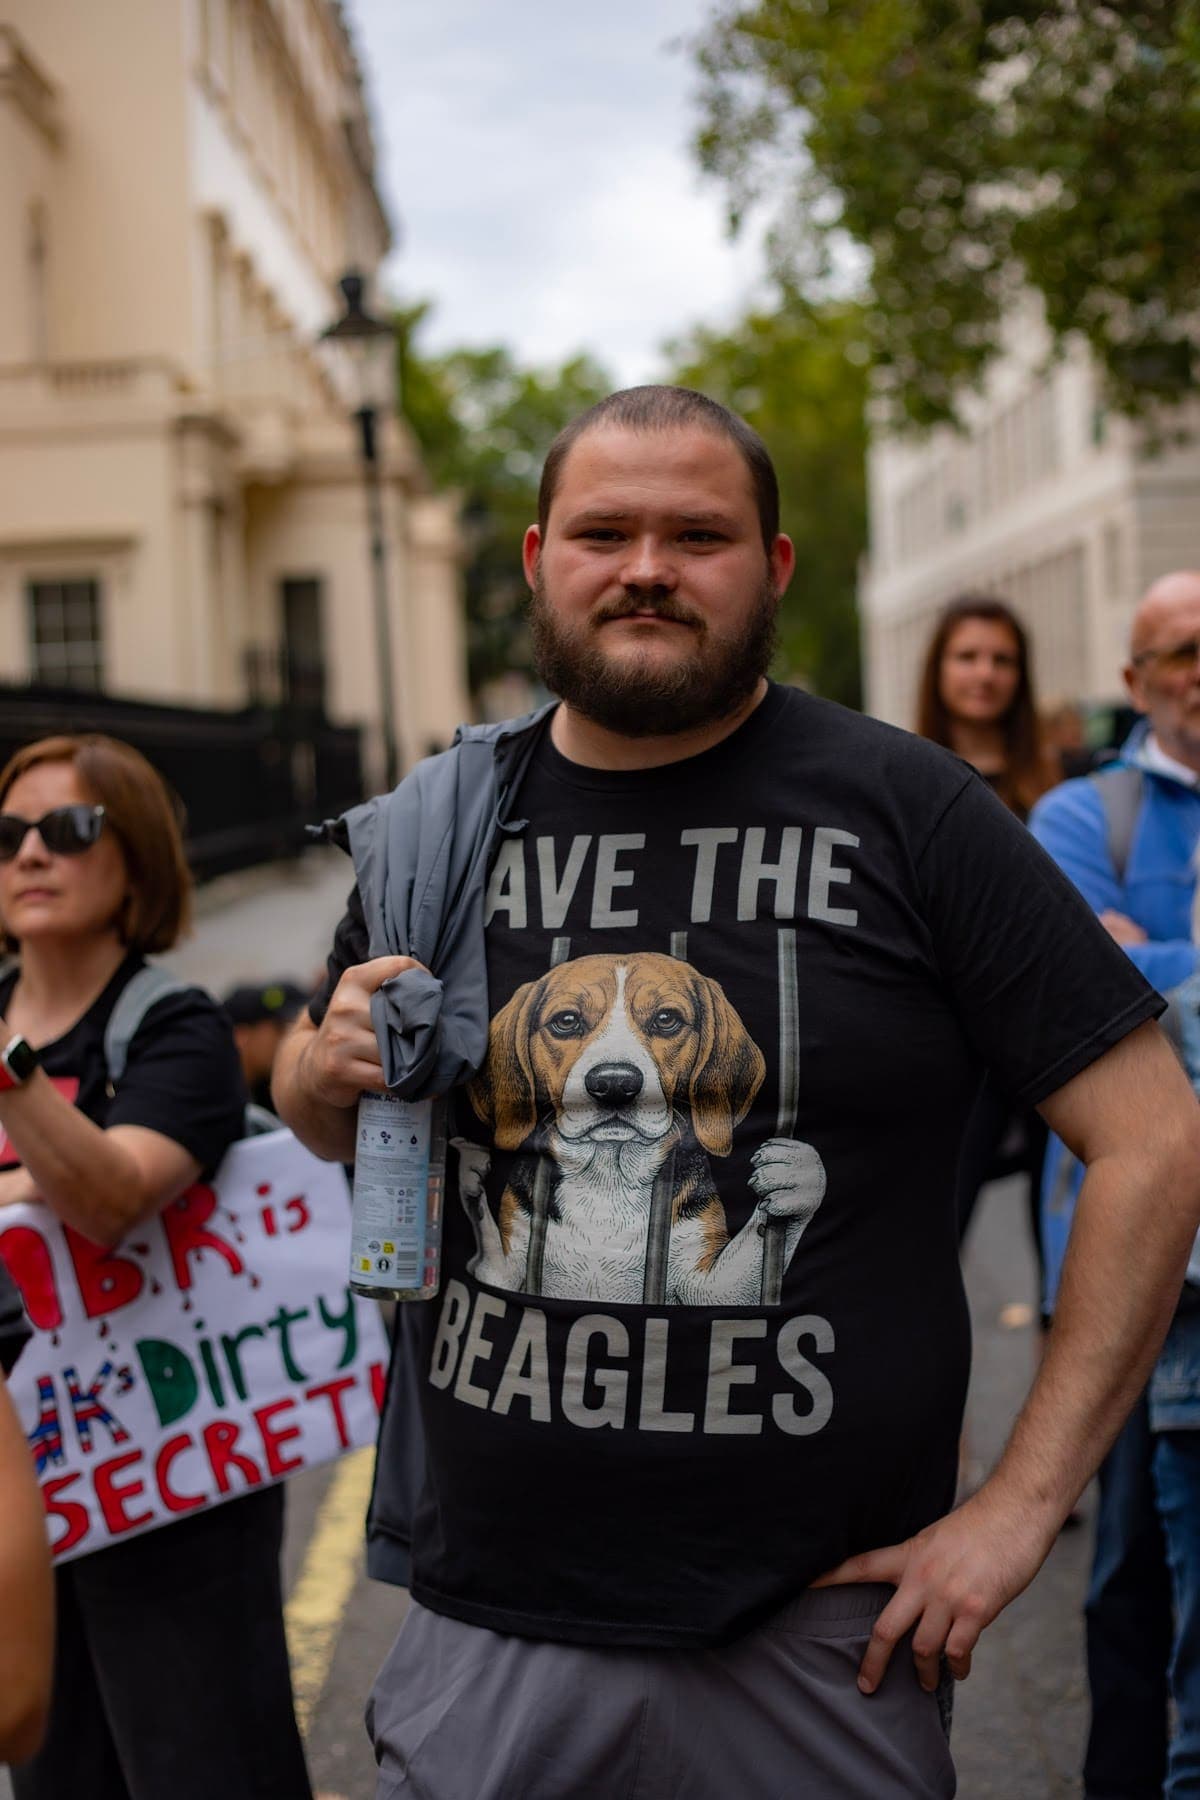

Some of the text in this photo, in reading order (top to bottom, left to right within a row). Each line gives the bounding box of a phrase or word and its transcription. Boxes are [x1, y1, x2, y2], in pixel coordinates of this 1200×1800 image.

[484, 826, 860, 929] AVE THE
[0, 1183, 243, 1330] BR
[256, 1183, 311, 1237] is
[136, 1286, 357, 1427] Dirty
[428, 1278, 836, 1436] BEAGLES
